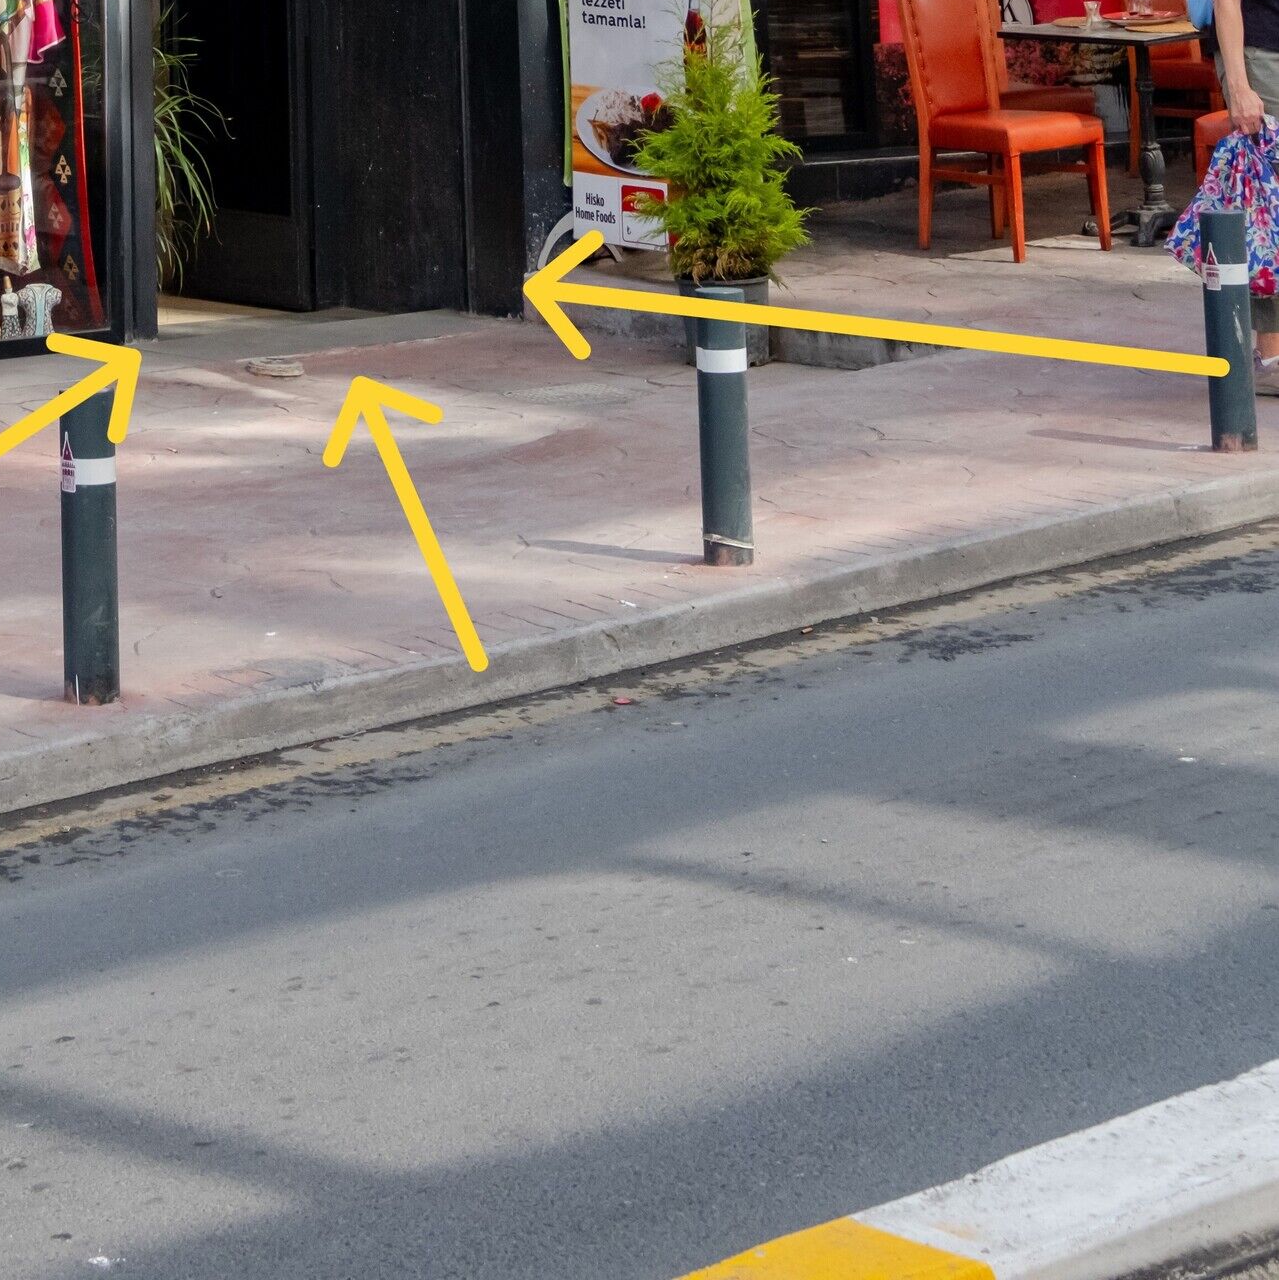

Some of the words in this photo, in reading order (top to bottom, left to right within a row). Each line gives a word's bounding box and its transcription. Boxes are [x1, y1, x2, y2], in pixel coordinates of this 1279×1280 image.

[581, 10, 646, 29] tamamla!
[585, 192, 605, 207] Hisko
[575, 206, 595, 222] Home
[595, 208, 616, 225] Foods
